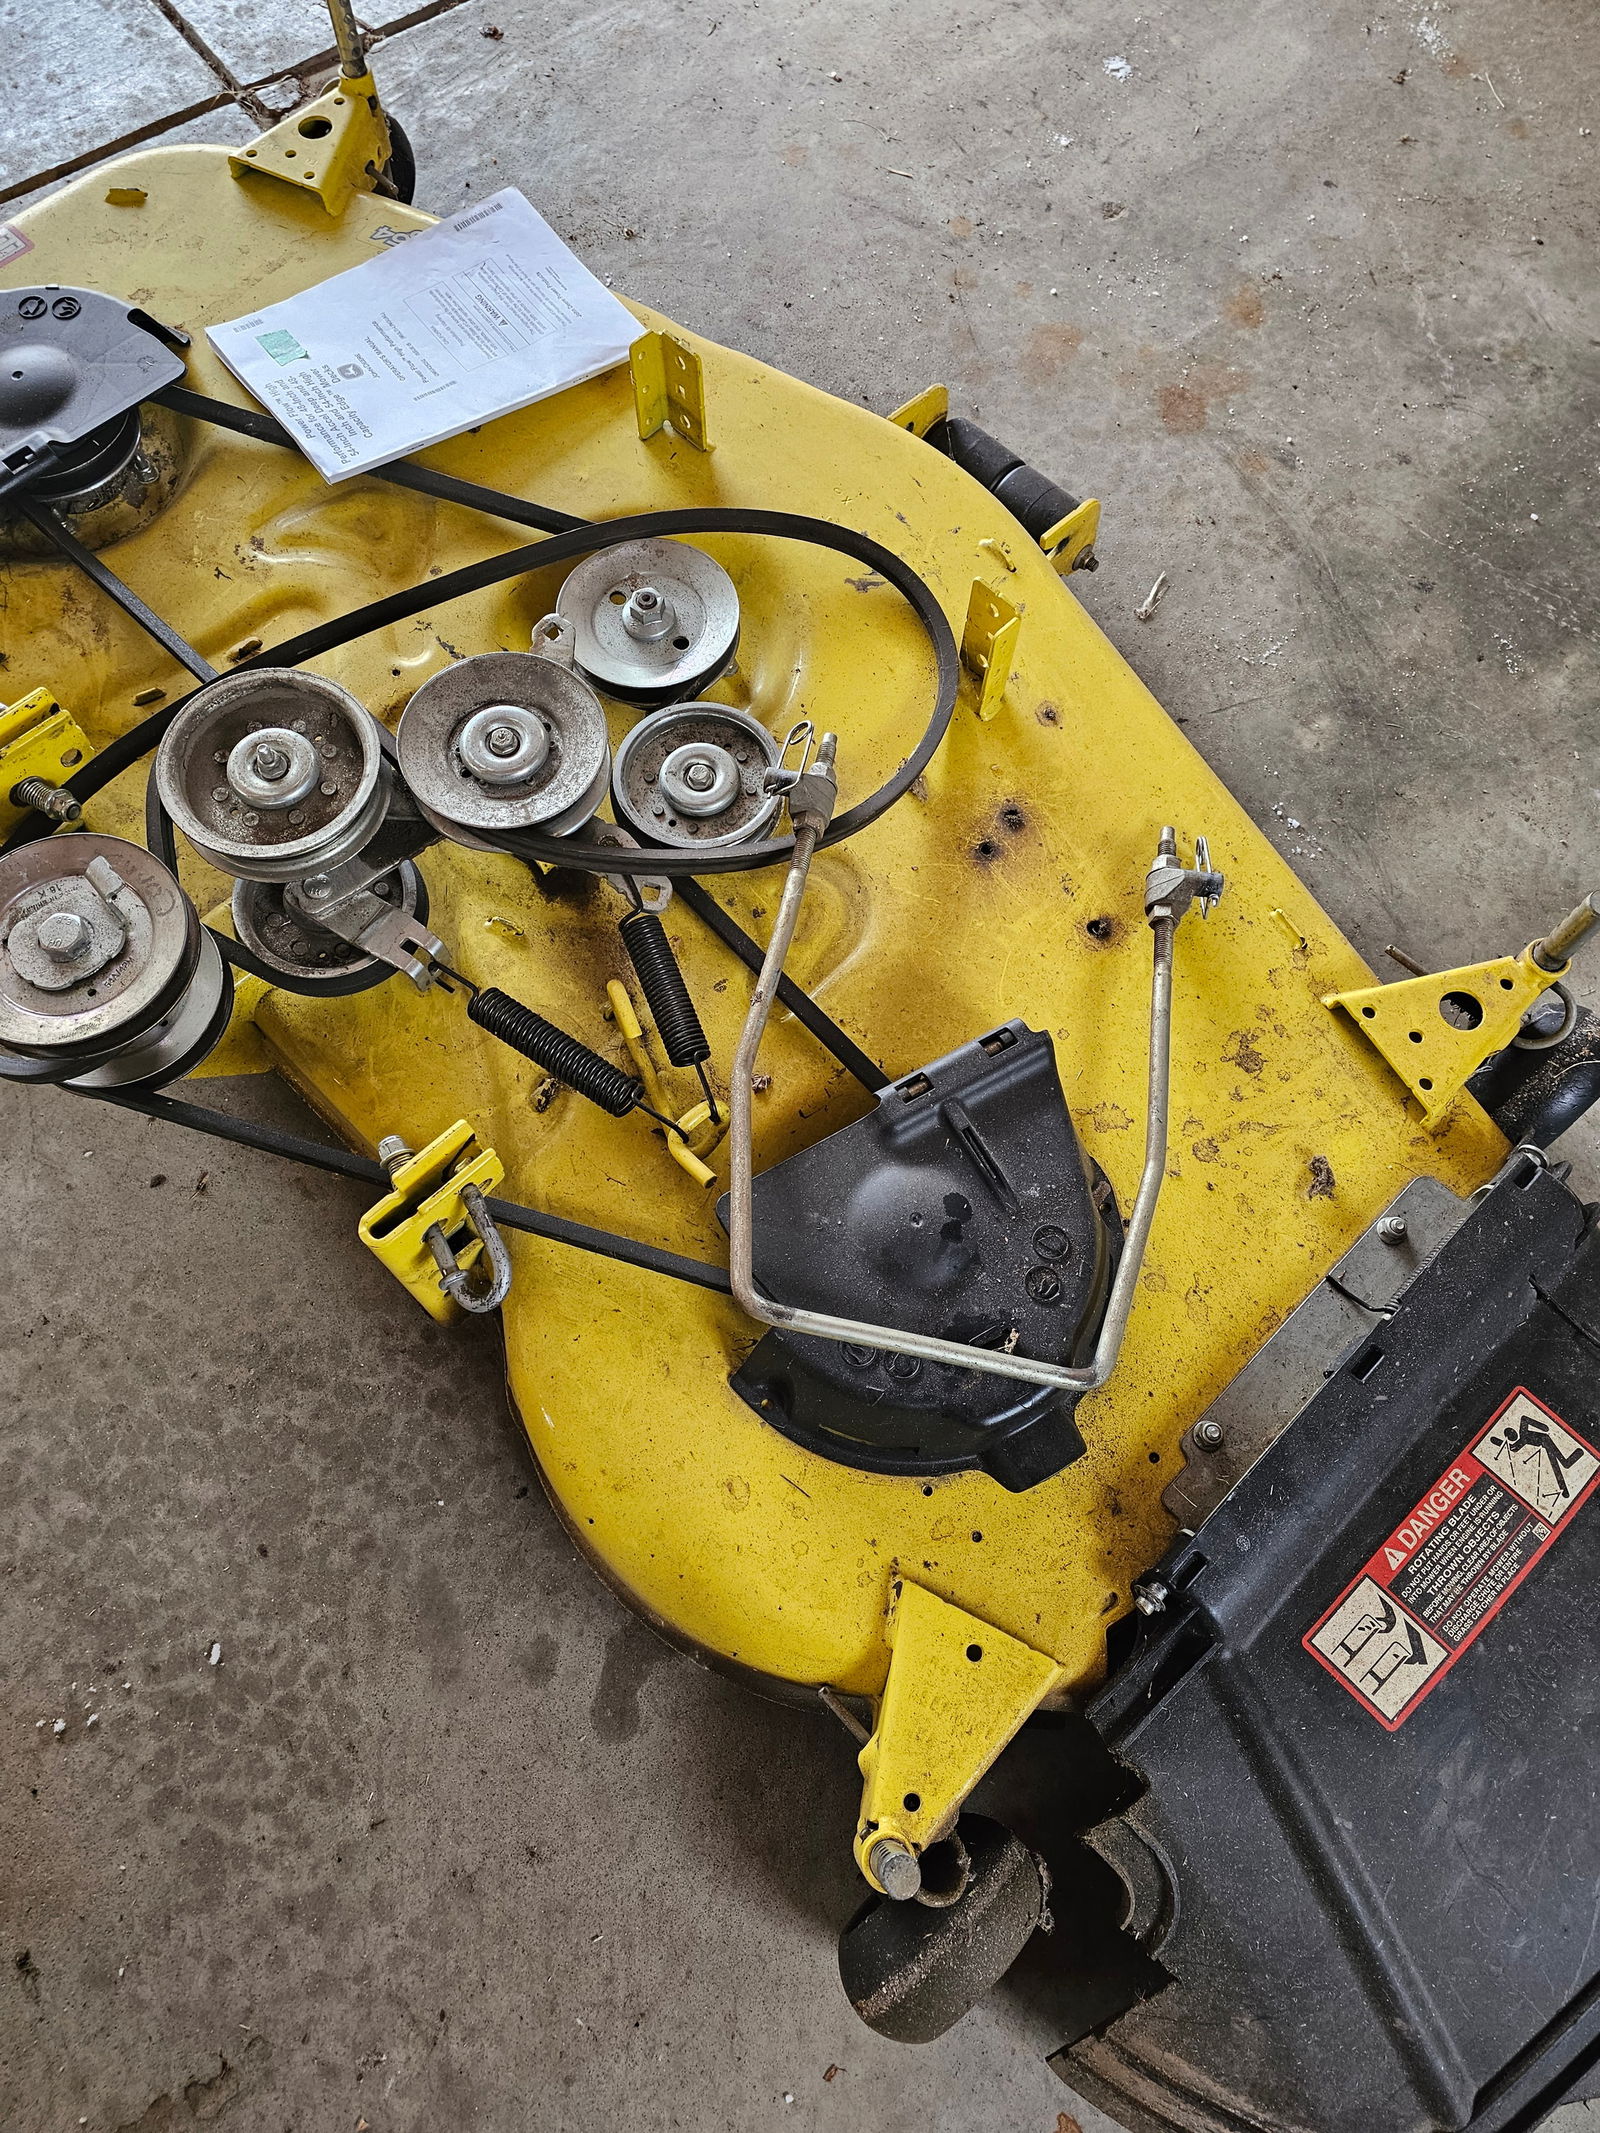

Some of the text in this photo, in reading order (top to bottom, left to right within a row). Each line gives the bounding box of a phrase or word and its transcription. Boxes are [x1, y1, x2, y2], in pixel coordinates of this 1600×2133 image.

[474, 292, 500, 320] WARNING
[371, 320, 396, 347] Performance
[393, 346, 405, 357] High
[321, 364, 341, 383] Decks
[364, 336, 406, 381] OPERATOR'S MANUAL
[414, 370, 429, 383] Power
[264, 382, 280, 397] High
[294, 384, 310, 397] and
[310, 368, 331, 388] Mower
[273, 379, 350, 464] Performance for 48-Inch and
[298, 371, 357, 437] Inch and 54-Inch High
[307, 397, 324, 413] Deep
[318, 413, 340, 431] Accel
[295, 418, 316, 439] Power
[346, 410, 373, 438] Capacity
[335, 432, 359, 456] 54-Inch
[1398, 1469, 1469, 1548] DANGER
[1401, 1484, 1497, 1598] DO NOT PUT HANDS OR FEET UNDER OR
[1407, 1490, 1503, 1604] INTO MOWER WHEN ENGINE IS RUNNING
[1408, 1494, 1476, 1574] ROTATING BLADE
[1422, 1503, 1518, 1618] BEFORE MOWING, CLEAR AREA OF OBJECTS
[1427, 1511, 1499, 1595] THROWN OBJECTS
[1428, 1529, 1508, 1623] THAT MAY BE THROWN BY BLADE
[1442, 1522, 1533, 1632] DO NOT OPERATE MOWER WITHOUT
[1447, 1547, 1522, 1637] DISCHARGE CHUTE OR ENTIRE
[1453, 1562, 1520, 1641] GRASS CATCHER IN PLACE
